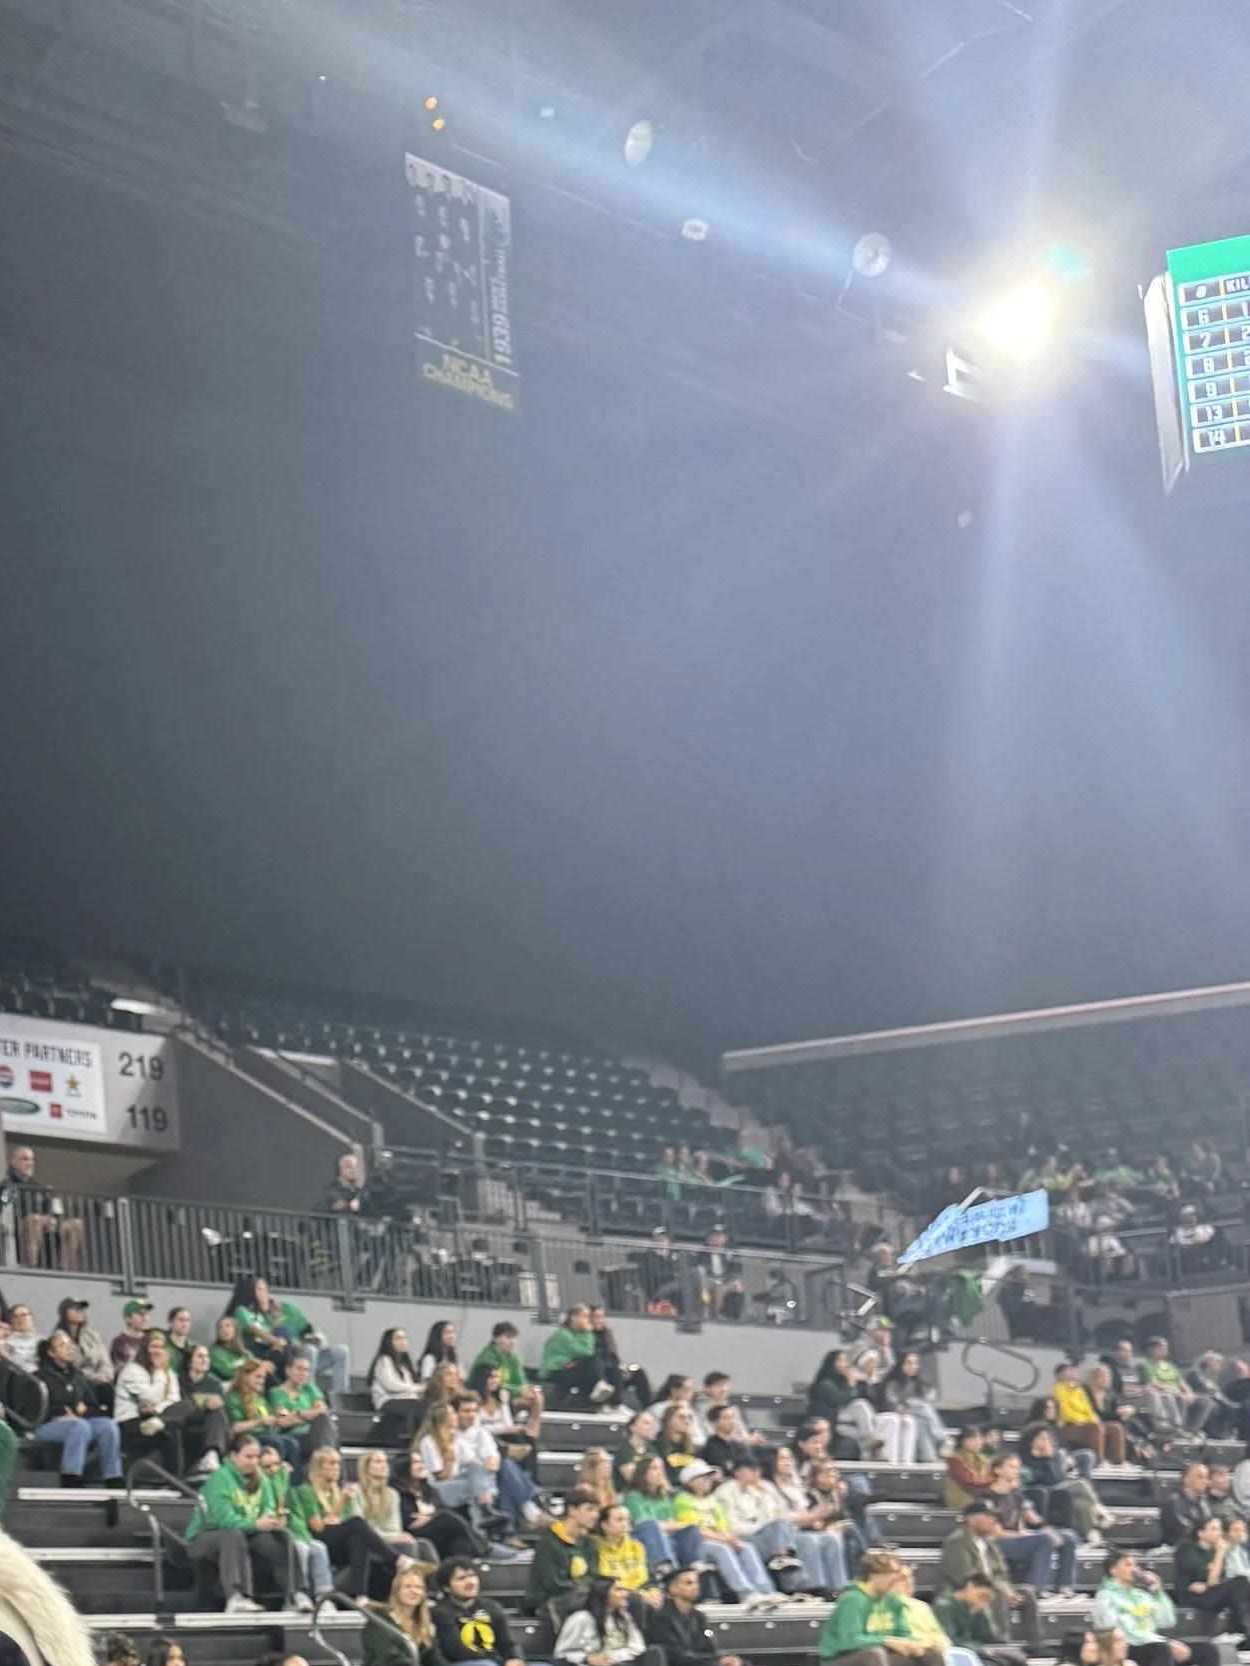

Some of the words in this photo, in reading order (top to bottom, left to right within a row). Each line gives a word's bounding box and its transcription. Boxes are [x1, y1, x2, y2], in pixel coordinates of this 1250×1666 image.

[1198, 308, 1210, 325] 6
[1199, 331, 1211, 348] 7
[1206, 404, 1223, 422] 13
[1207, 429, 1226, 446] 14
[24, 1041, 93, 1068] PARTNERS
[118, 1051, 165, 1082] 219
[126, 1103, 168, 1133] 119
